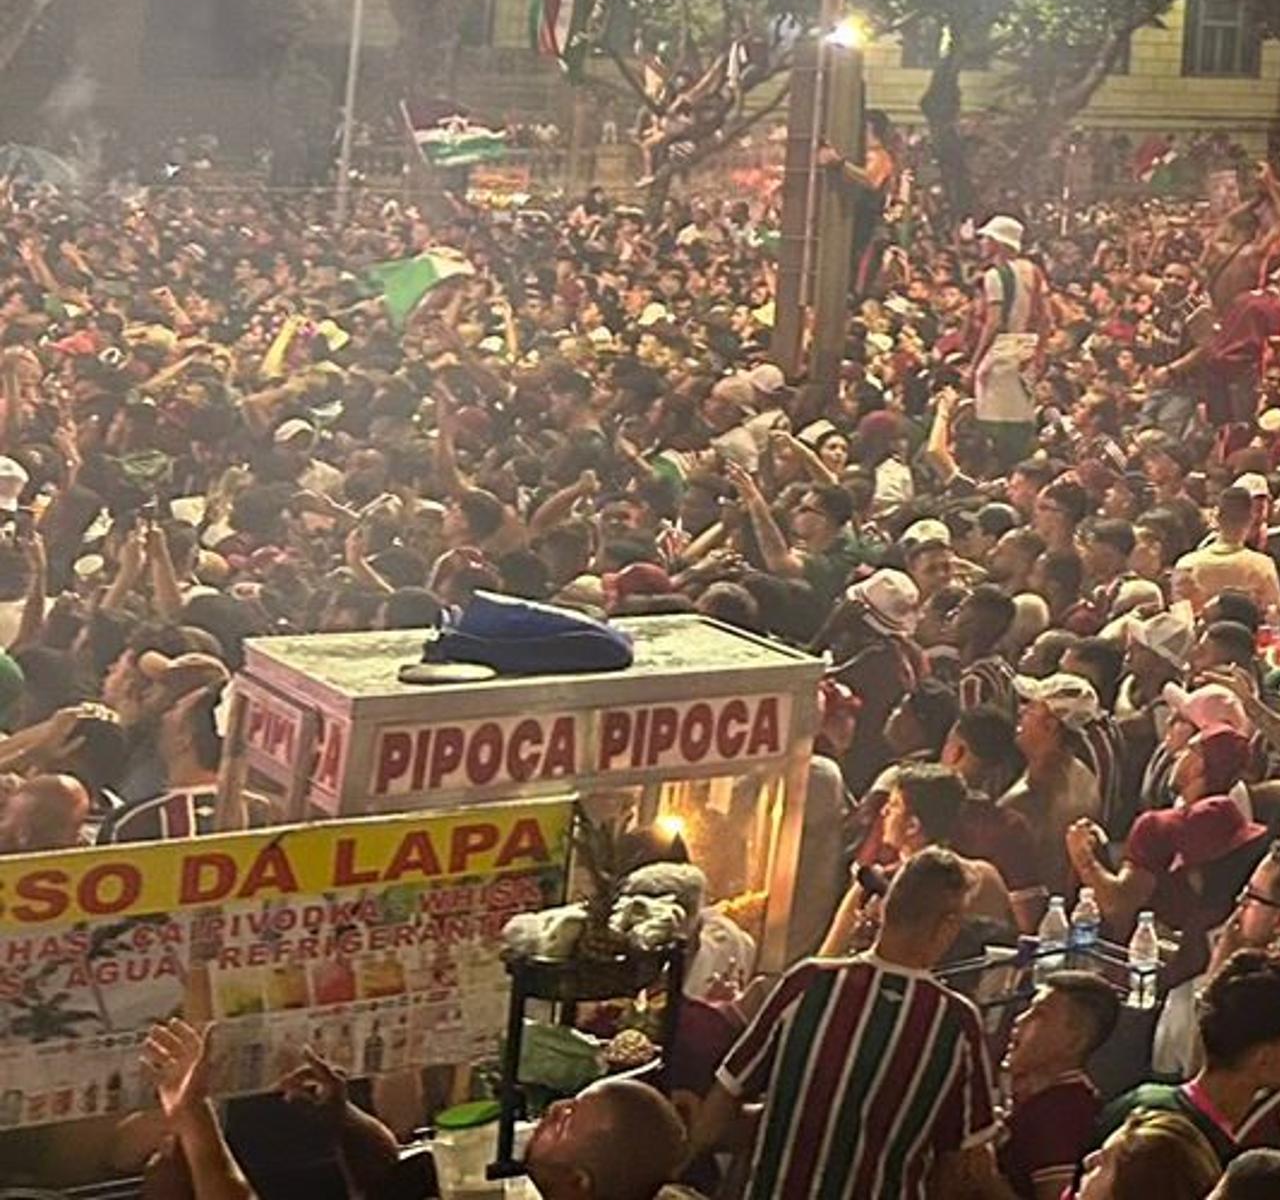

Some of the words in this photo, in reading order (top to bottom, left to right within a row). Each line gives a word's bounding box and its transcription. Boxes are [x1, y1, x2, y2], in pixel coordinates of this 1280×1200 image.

[599, 699, 780, 769] PIPOCA
[0, 863, 142, 923] SO
[332, 817, 548, 887] LAPA
